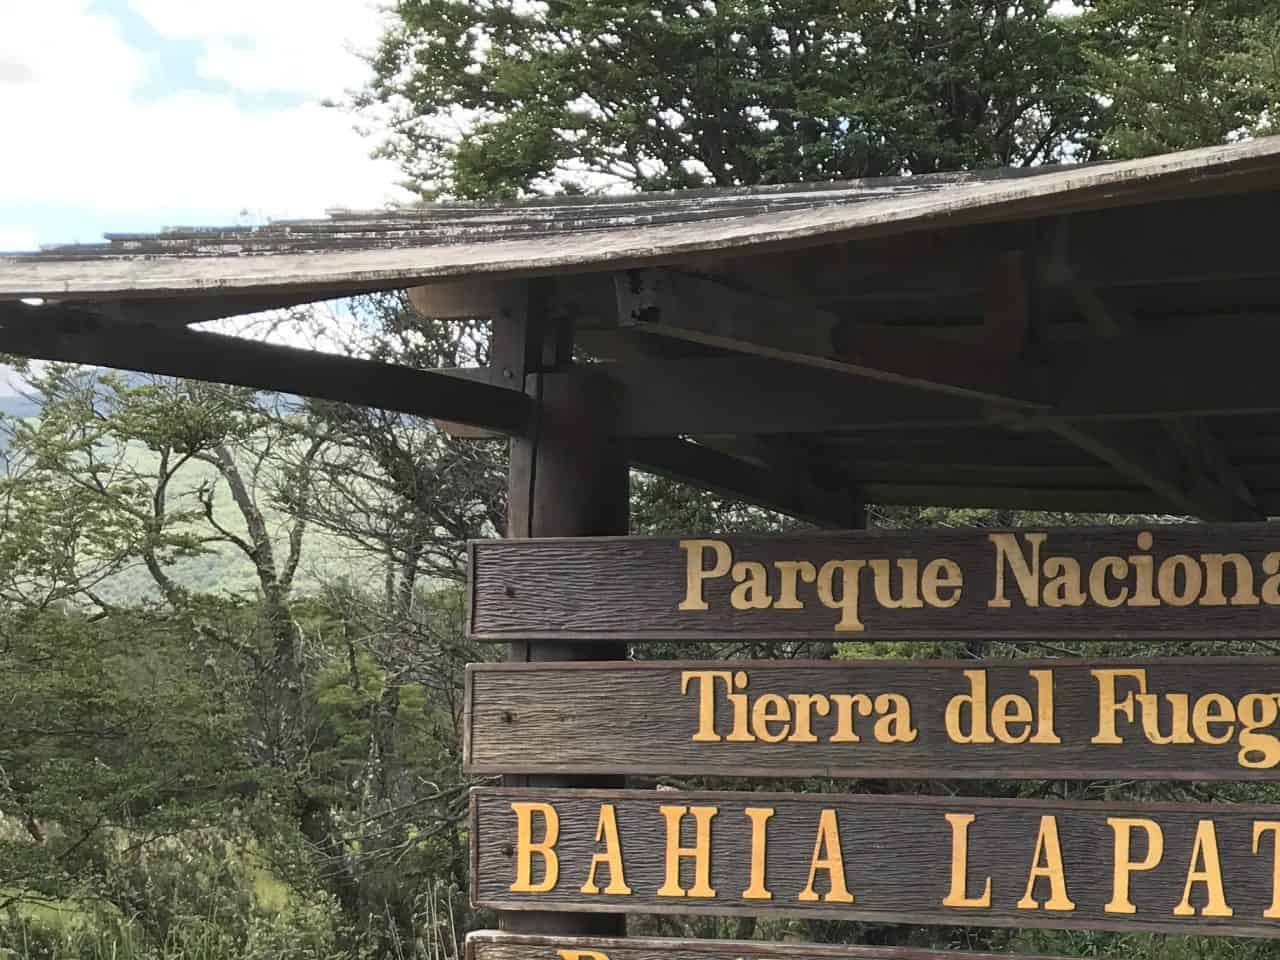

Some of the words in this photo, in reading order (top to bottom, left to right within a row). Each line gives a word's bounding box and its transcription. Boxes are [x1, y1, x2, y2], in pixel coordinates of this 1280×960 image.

[678, 540, 963, 632] Parque
[681, 670, 917, 743] Tierra
[945, 669, 1061, 745] del
[510, 802, 854, 904] BAHIA
